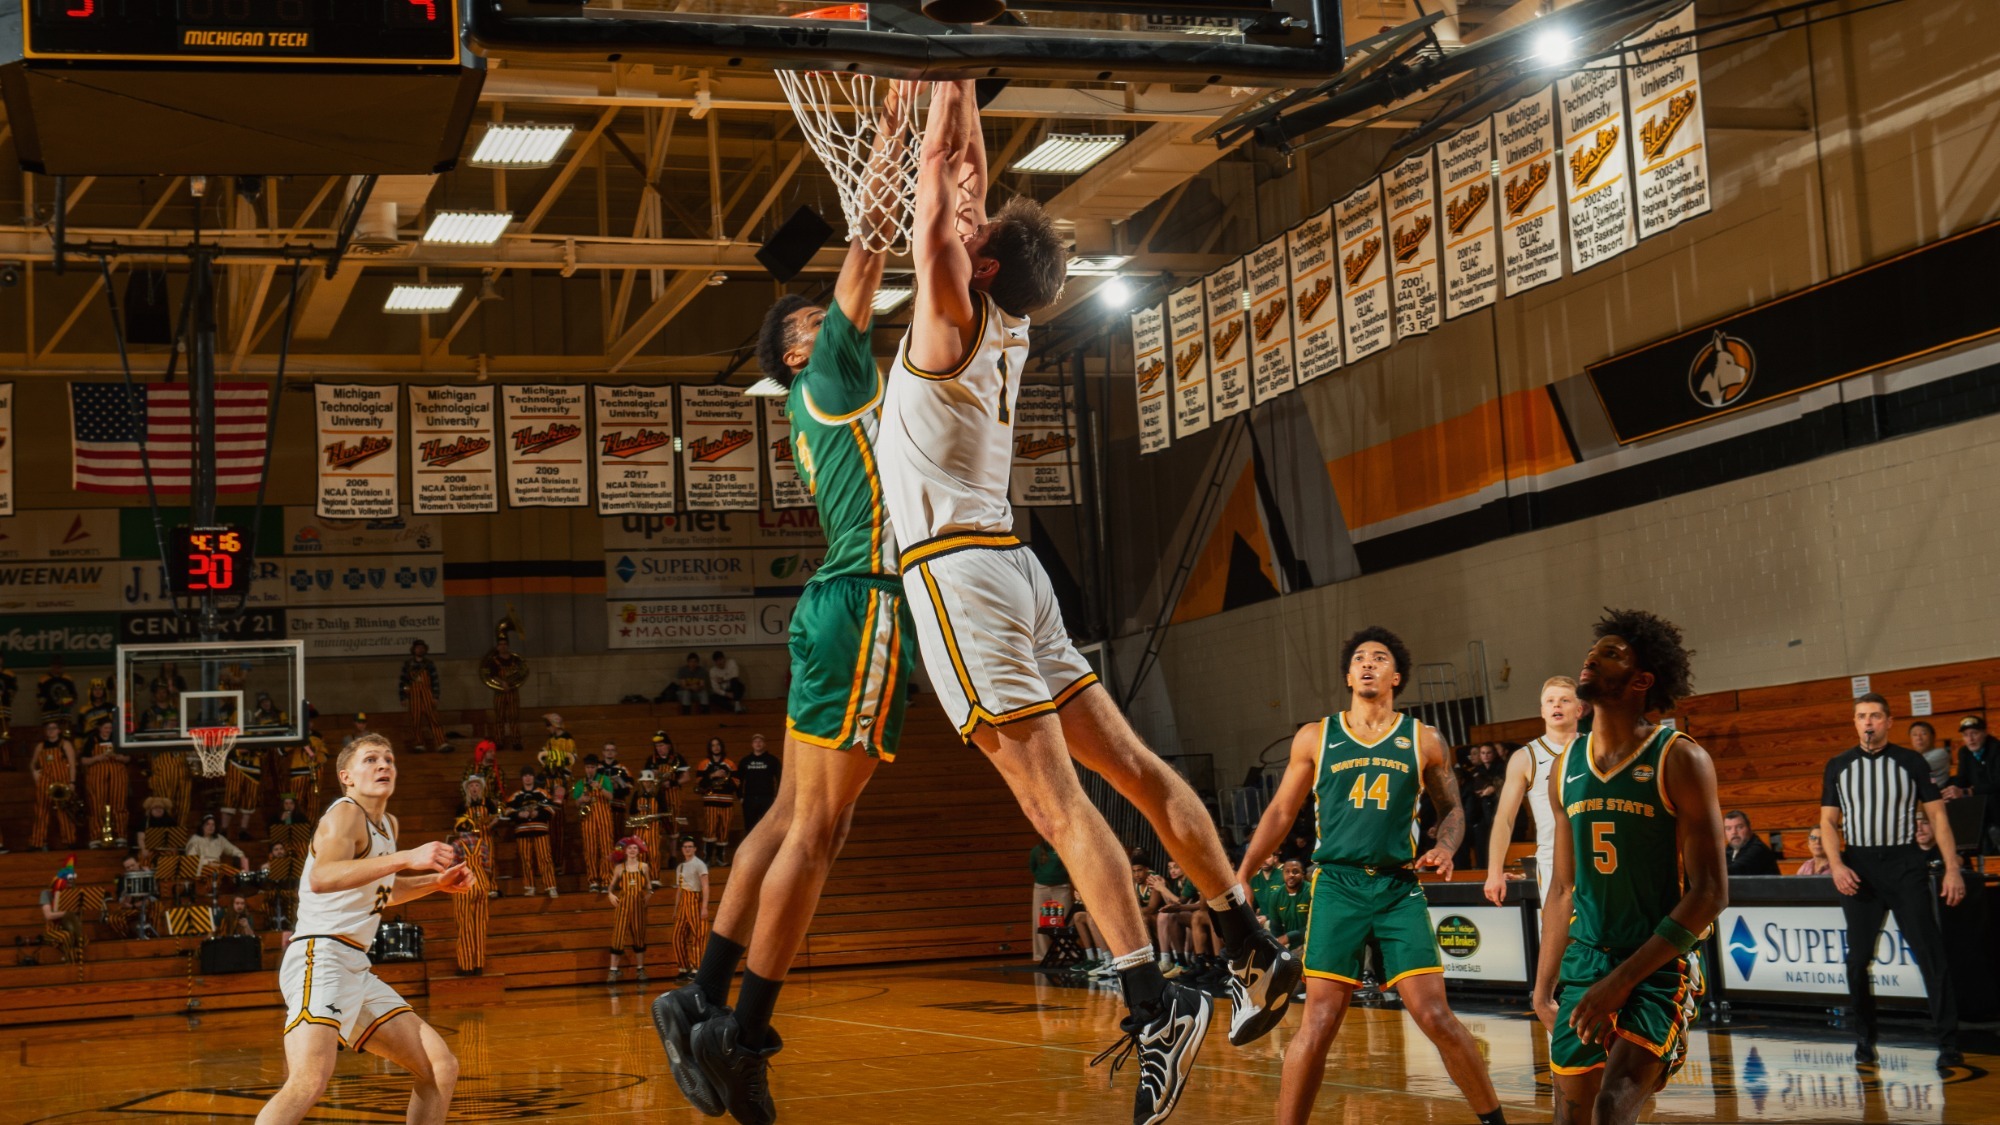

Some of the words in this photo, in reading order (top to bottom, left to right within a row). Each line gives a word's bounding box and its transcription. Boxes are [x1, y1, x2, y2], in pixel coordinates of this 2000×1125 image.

[184, 31, 264, 46] MICHIGAN
[268, 33, 308, 46] TECH
[1641, 65, 1685, 97] University
[1563, 70, 1618, 115] Technological
[1507, 102, 1540, 128] Michigan
[1571, 100, 1610, 133] University
[1499, 109, 1550, 147] Technological
[1640, 90, 1696, 164] Huskies
[1448, 130, 1480, 152] Michigan
[1442, 137, 1489, 169] Technological
[1506, 137, 1543, 164] University
[1569, 124, 1619, 190] Huskies
[1449, 160, 1482, 182] University
[1504, 160, 1551, 219] Huskies
[1643, 183, 1664, 200] NCAA
[1445, 182, 1490, 238] Huskies
[1572, 210, 1590, 228] NCAA
[1593, 199, 1619, 219] Division
[1516, 217, 1543, 237] 2002-03
[1519, 231, 1541, 249] GLIAC
[1597, 235, 1623, 256] Record
[333, 388, 381, 401] Michigan
[427, 390, 476, 402] Michigan
[521, 387, 567, 396] Michigan
[611, 389, 655, 399] Michigan
[697, 388, 741, 398] Michigan
[509, 395, 580, 405] Technological
[600, 399, 668, 410] Technological
[685, 399, 753, 410] Technological
[321, 402, 393, 415] Technological
[415, 402, 489, 415] Technological
[520, 405, 570, 415] University
[609, 410, 659, 419] University
[695, 410, 743, 420] University
[331, 415, 383, 429] University
[426, 416, 480, 428] University
[511, 423, 581, 456] Huskies
[600, 429, 670, 459] Huskies
[687, 430, 754, 462] Huskies
[323, 436, 392, 470] Huskies
[418, 436, 490, 467] Huskies
[535, 467, 560, 475] 2009
[623, 471, 648, 479] 2017
[708, 474, 737, 482] 2018
[346, 479, 369, 487] 2006
[606, 482, 628, 490] NCAA
[1035, 476, 1058, 484] GLIAC
[324, 488, 348, 496] NCAA
[351, 488, 382, 496] Division
[421, 484, 446, 492] NCAA
[450, 484, 481, 493] Division
[324, 507, 355, 515] Women's
[358, 507, 391, 517] Volleyball
[419, 502, 454, 511] Women's
[457, 502, 492, 511] Volleyball
[602, 501, 636, 510] Women's
[637, 501, 672, 511] Volleyball
[692, 535, 732, 544] Telephone
[761, 529, 775, 537] The
[641, 557, 742, 574] SUPERIOR
[692, 604, 728, 612] MOTEL
[254, 616, 273, 633] 21
[291, 618, 313, 630] The
[317, 617, 350, 630] Daily
[355, 617, 397, 629] Mining
[399, 615, 440, 627] Gazette
[636, 624, 747, 638] MAGNUSON
[1331, 758, 1370, 774] WAYNE
[1372, 757, 1409, 774] STATE
[1348, 772, 1390, 810] 44
[1606, 798, 1655, 817] STATE
[1591, 822, 1618, 874] 5
[1440, 935, 1454, 946] Land
[1455, 935, 1476, 946] Brokers
[1785, 971, 1846, 985] NATIONA
[1869, 974, 1901, 987] ANK
